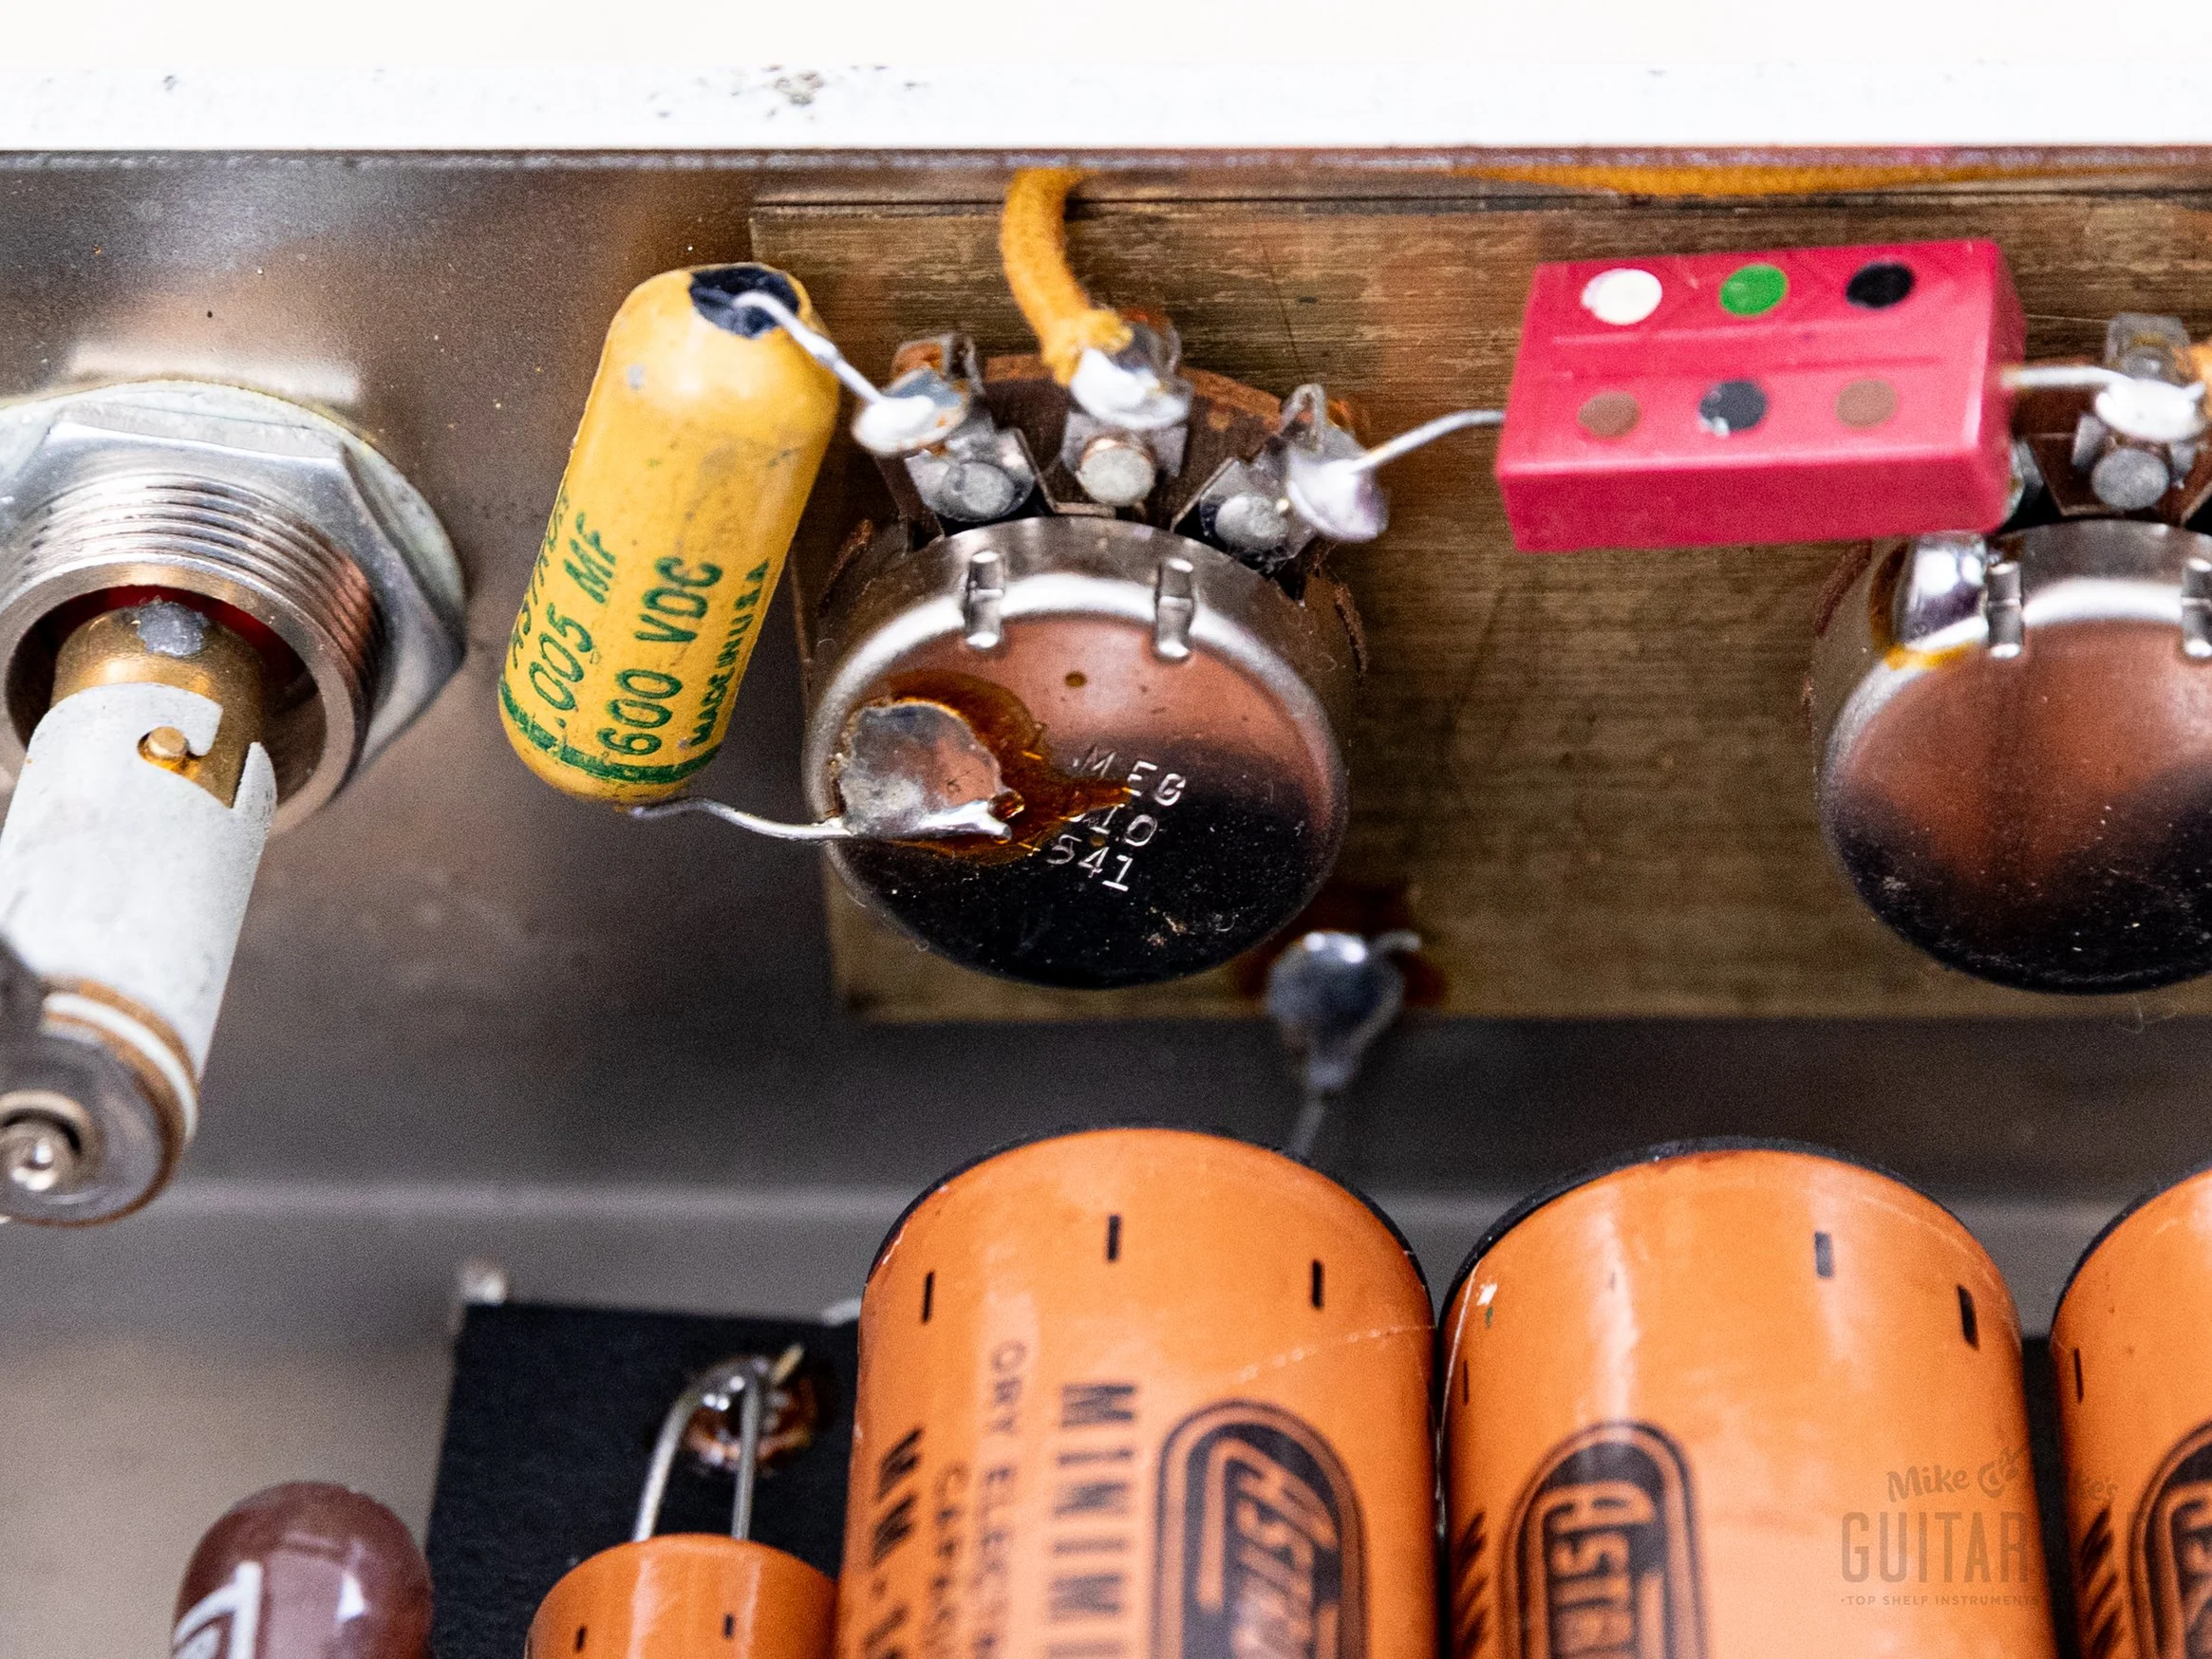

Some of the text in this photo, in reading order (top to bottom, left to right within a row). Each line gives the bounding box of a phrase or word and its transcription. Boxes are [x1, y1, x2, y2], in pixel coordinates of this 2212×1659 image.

[564, 511, 617, 604] MF
[596, 556, 724, 756] 600 VDC
